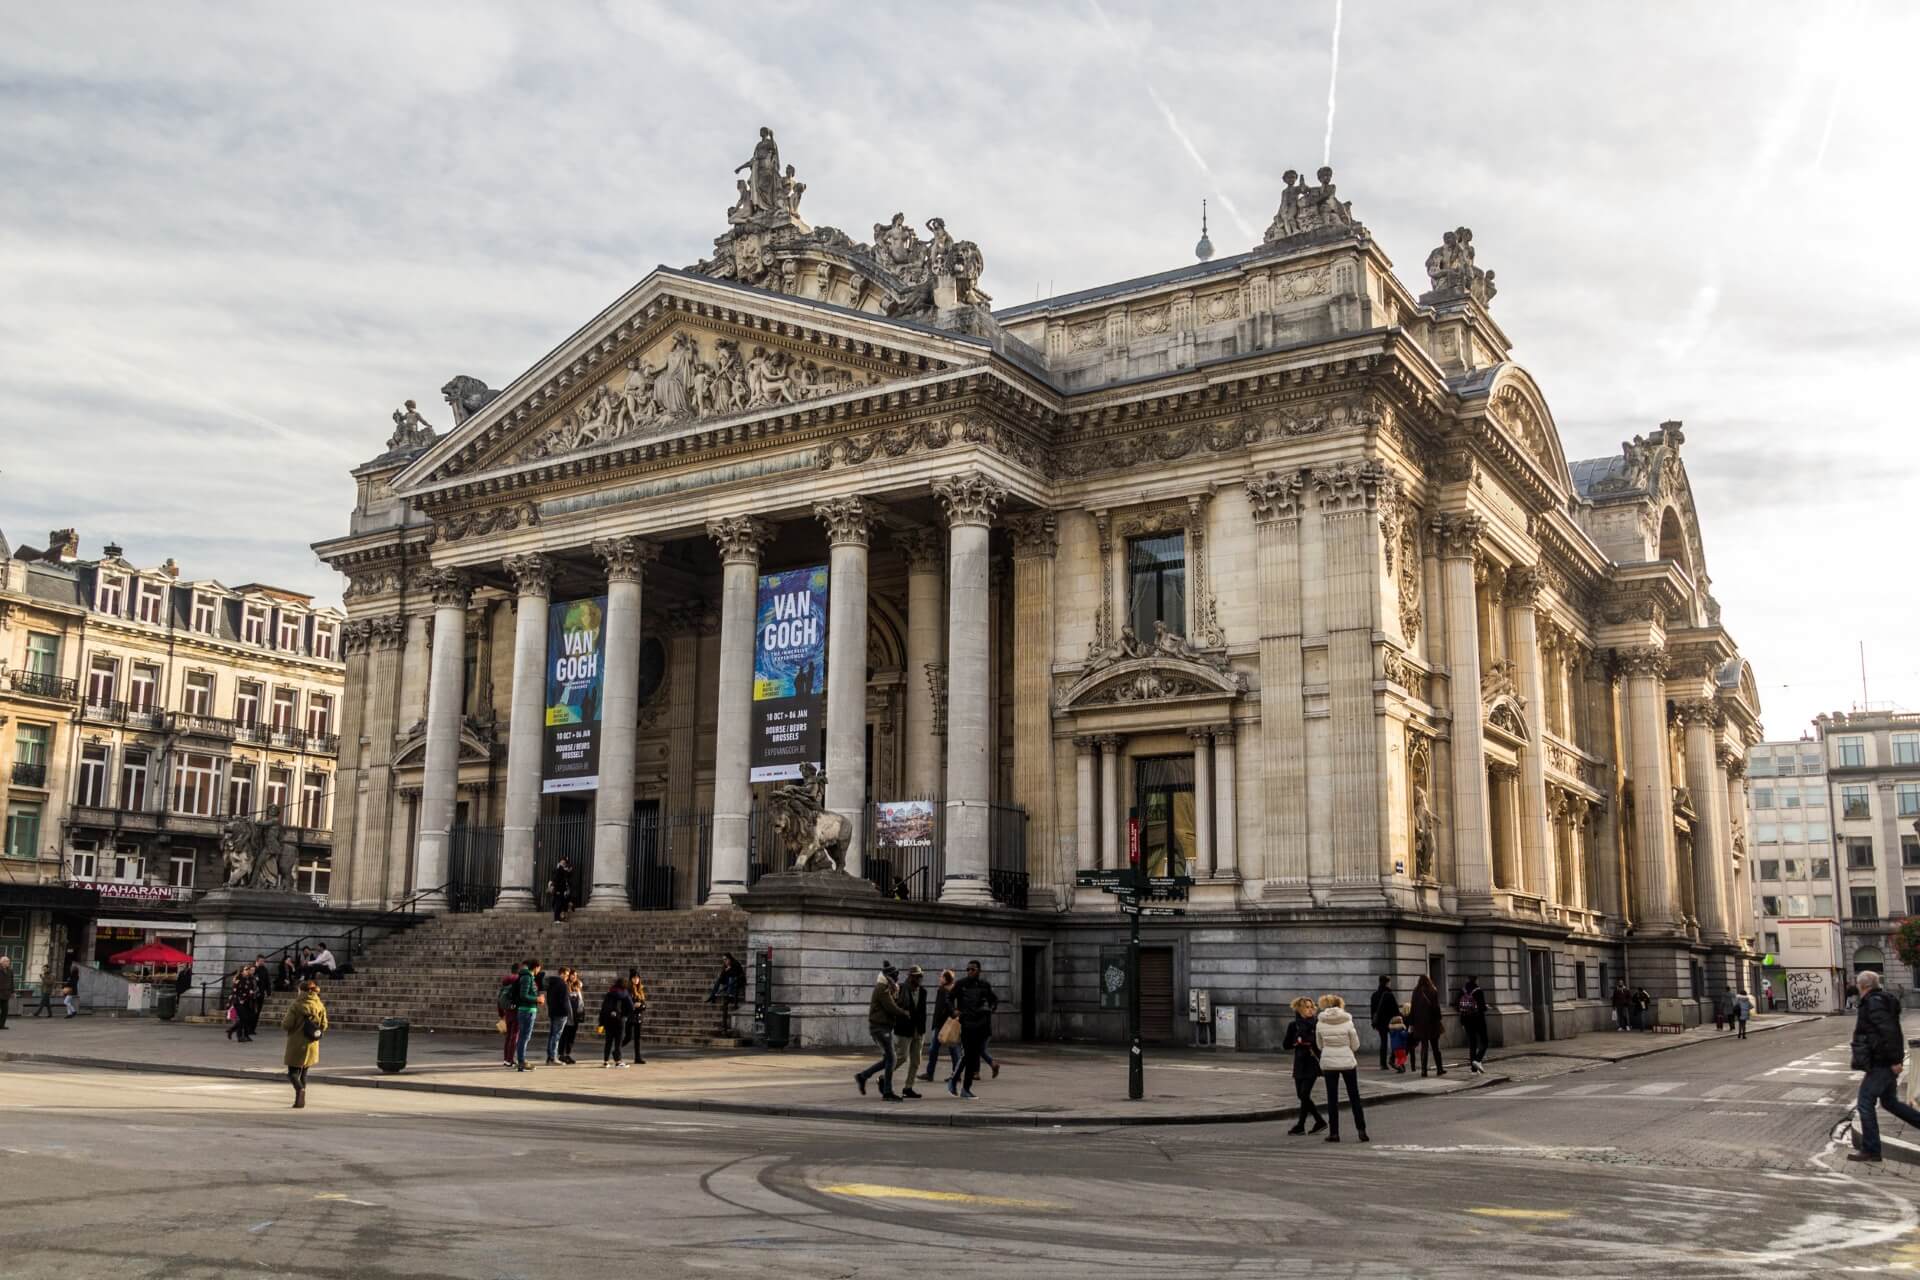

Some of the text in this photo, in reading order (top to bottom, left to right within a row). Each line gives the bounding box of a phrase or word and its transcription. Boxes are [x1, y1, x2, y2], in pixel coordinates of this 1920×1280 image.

[774, 590, 810, 620] VAN
[564, 630, 592, 655] VAN
[765, 618, 817, 650] GOGH
[556, 654, 597, 681] GOGH
[773, 711, 784, 720] OCT
[797, 709, 808, 718] JAN
[772, 732, 799, 742] BRUSSELS
[96, 884, 172, 896] MAHARANI
